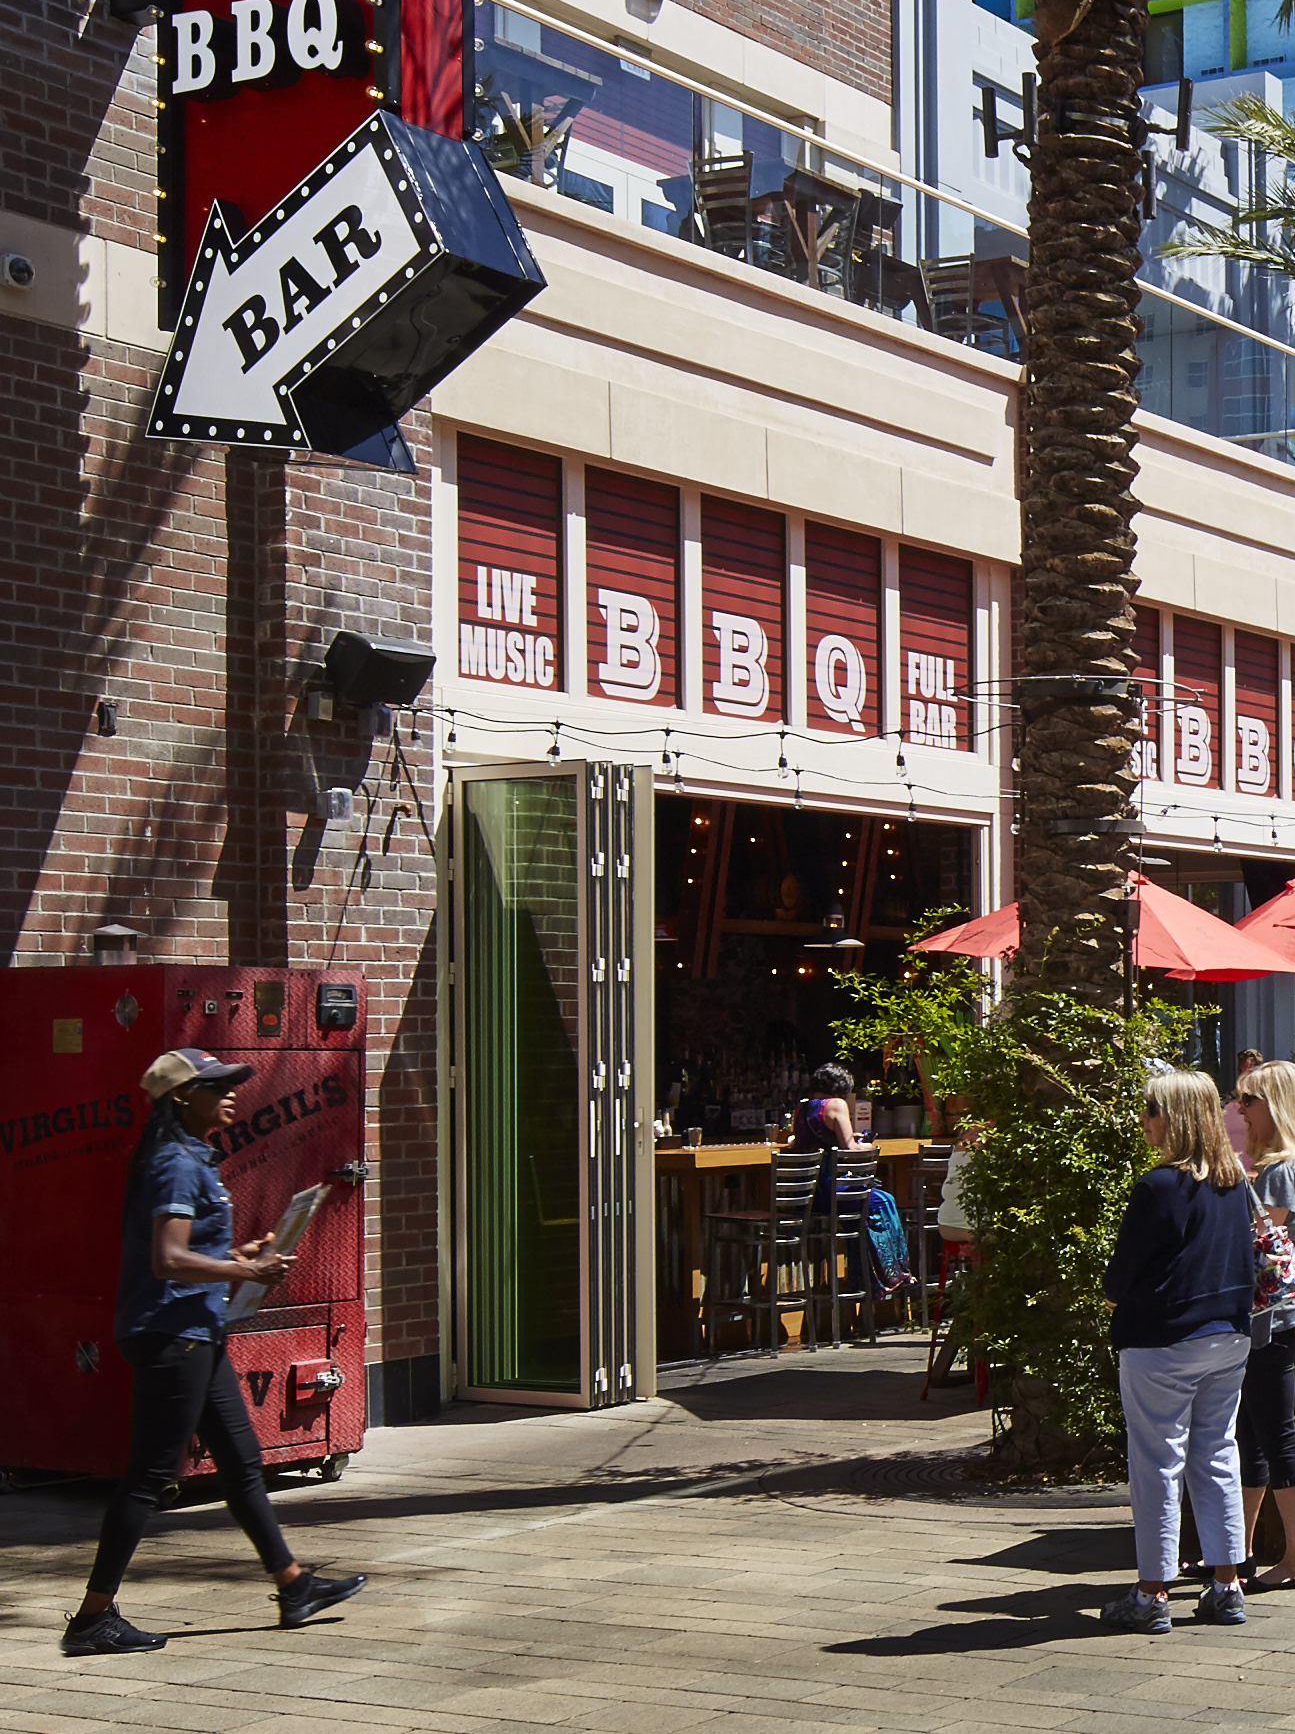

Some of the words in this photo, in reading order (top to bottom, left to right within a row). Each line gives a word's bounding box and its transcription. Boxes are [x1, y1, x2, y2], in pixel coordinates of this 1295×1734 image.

[223, 202, 382, 373] BAR
[476, 565, 537, 627] LIVE
[460, 625, 555, 688] MUSIC
[907, 651, 957, 702] FULL
[908, 700, 958, 750] BAR
[0, 1092, 133, 1155] VIRGIL'S
[208, 1073, 348, 1164] IRGIL'S
